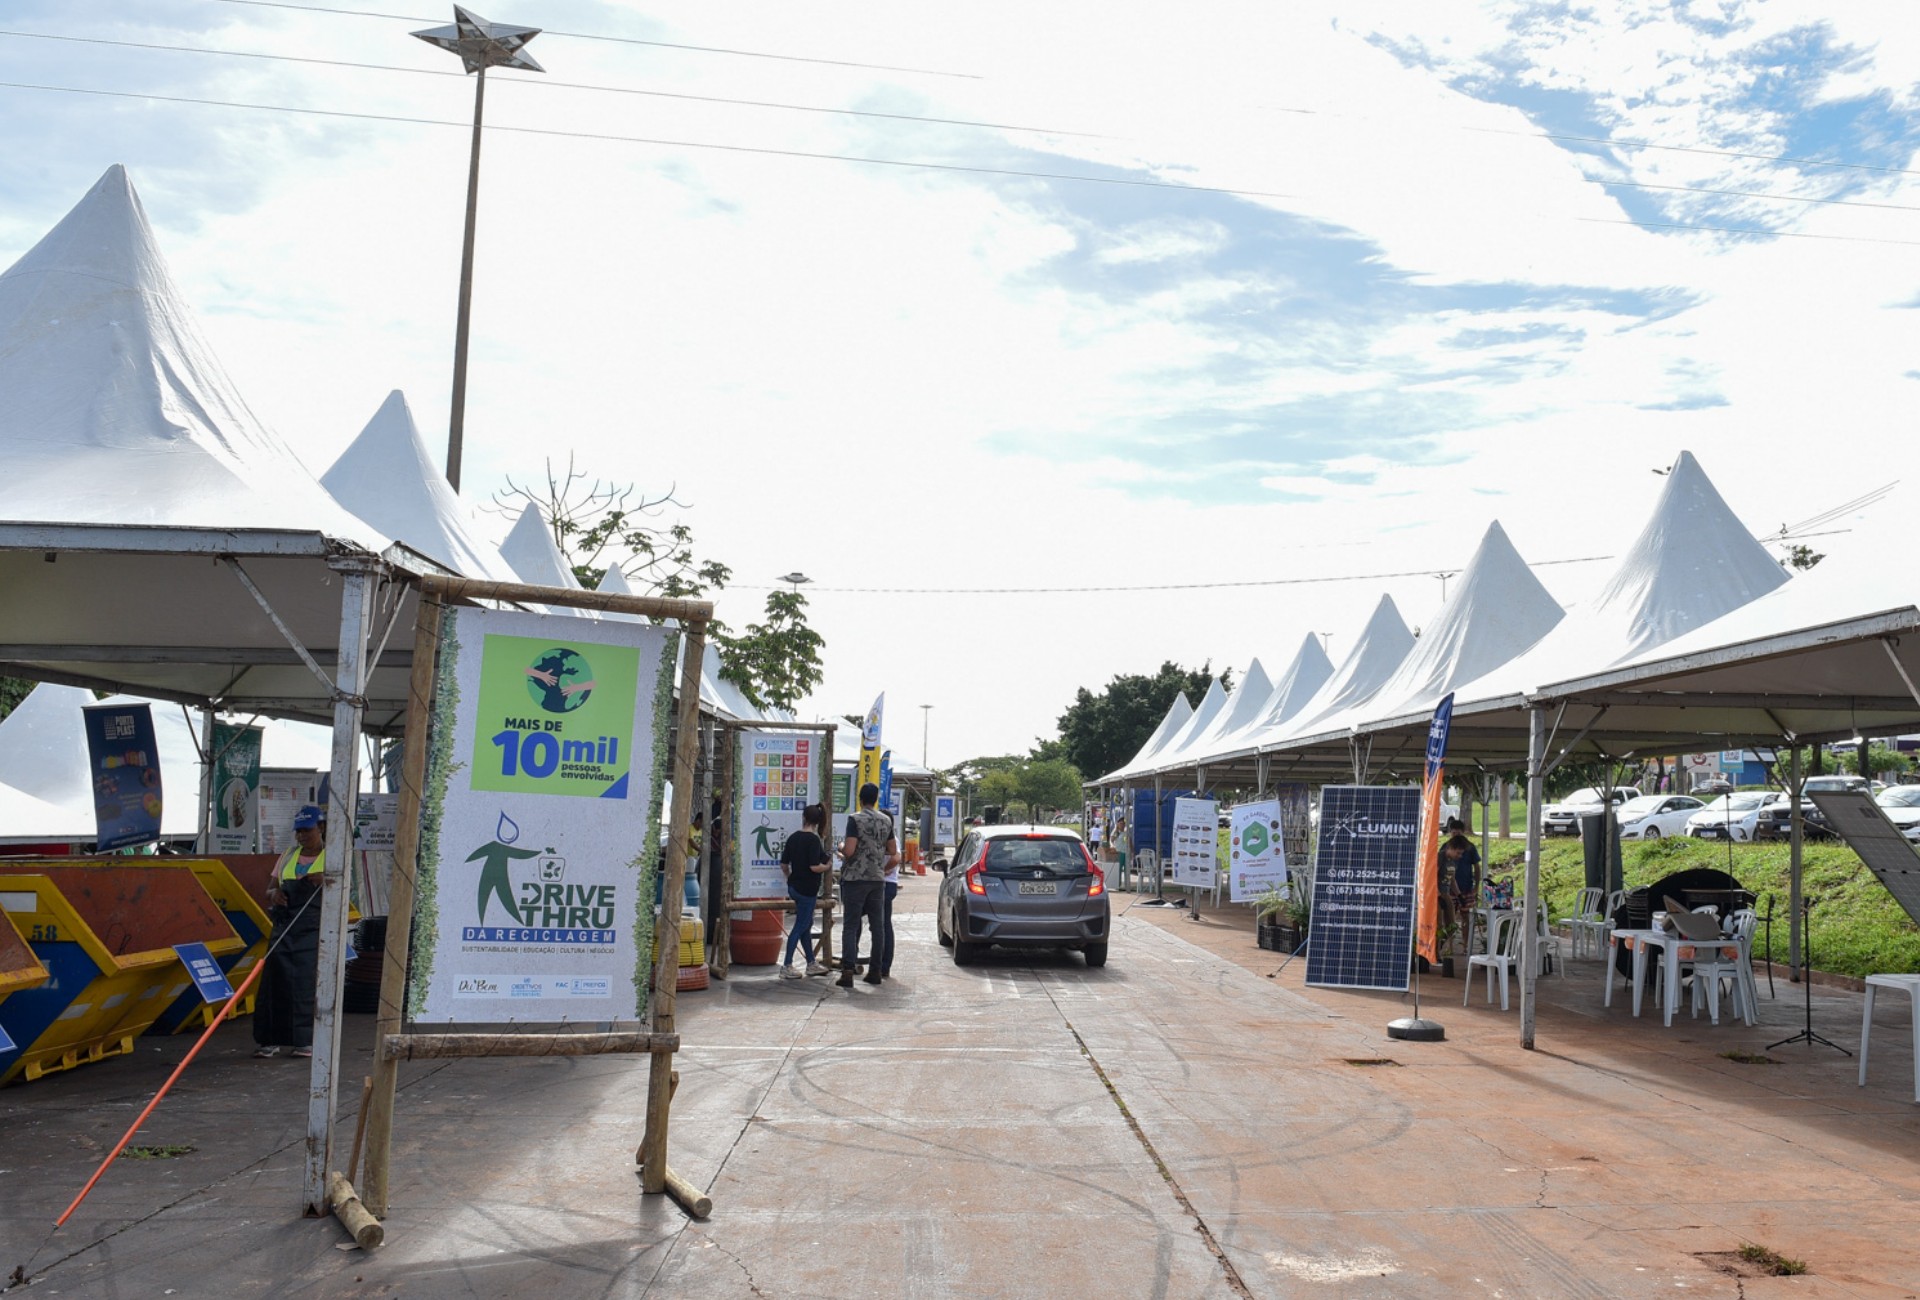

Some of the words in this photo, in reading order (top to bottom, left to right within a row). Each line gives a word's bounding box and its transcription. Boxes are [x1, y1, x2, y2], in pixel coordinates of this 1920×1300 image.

[504, 717, 540, 730] MAIS
[544, 720, 563, 732] DE
[491, 730, 560, 778] 10
[562, 736, 618, 765] mil
[561, 763, 602, 773] pessoas
[561, 771, 615, 781] envolvidas
[1358, 823, 1415, 834] LUMINI
[1337, 869, 1354, 878] (67)
[1356, 870, 1401, 879] 2525-4242
[521, 883, 616, 907] DRIVE
[519, 905, 615, 929] THRU
[31, 924, 58, 940] 58
[466, 928, 487, 940] DA
[495, 929, 613, 942] RECICLAGEM
[523, 946, 556, 954] EDUCAÇÃO
